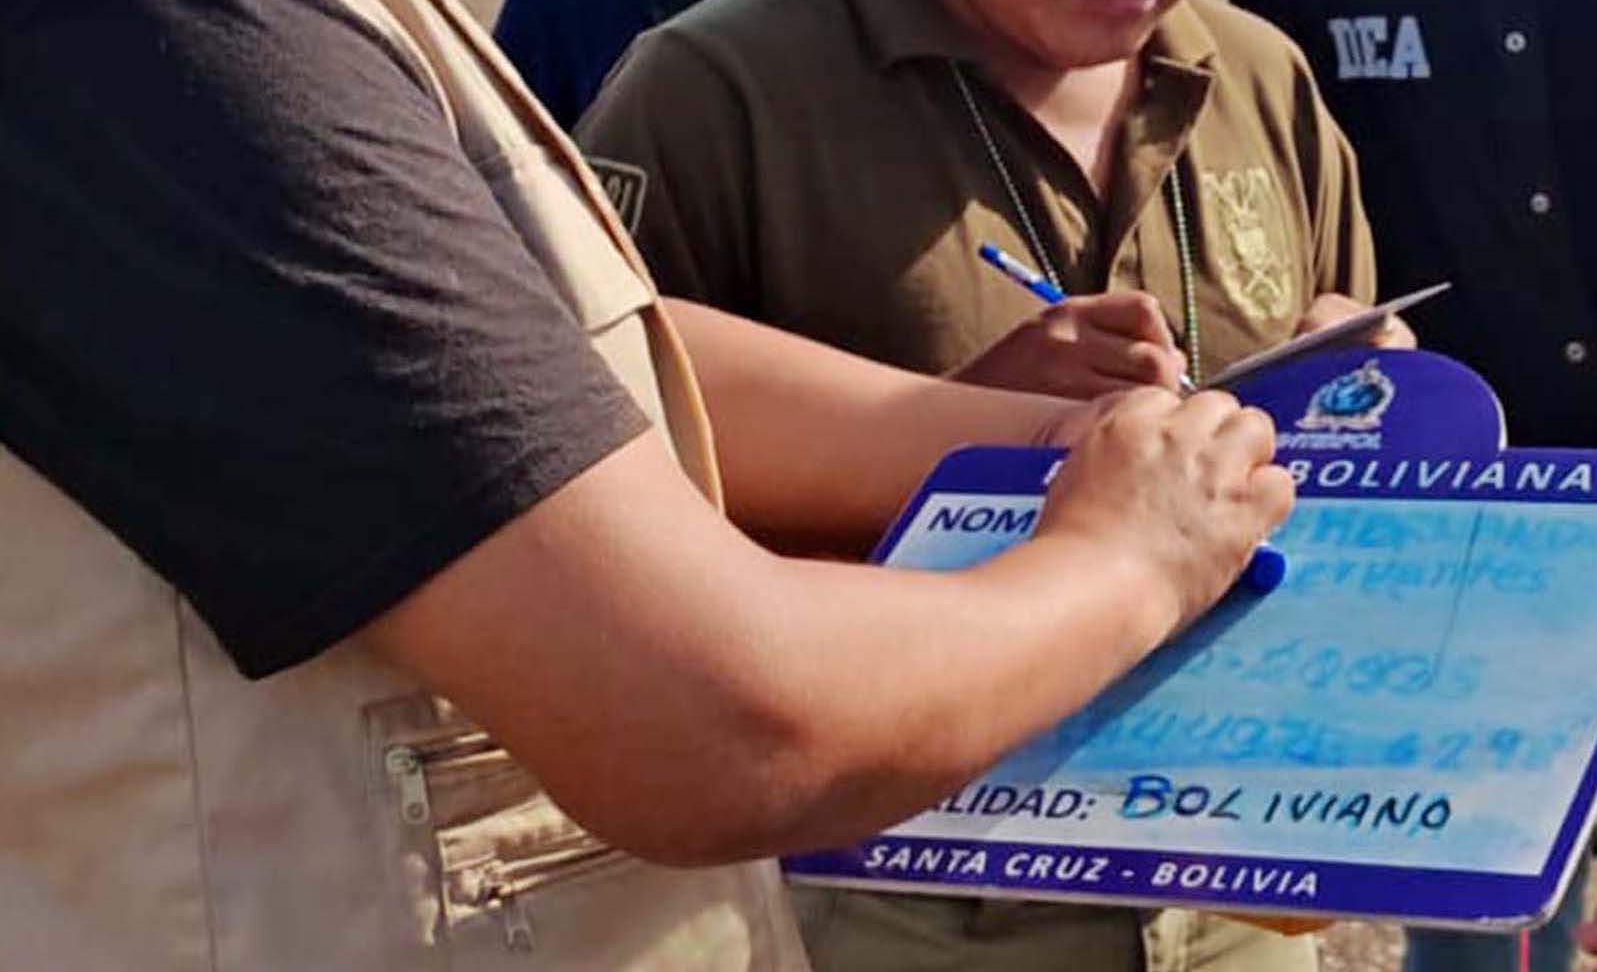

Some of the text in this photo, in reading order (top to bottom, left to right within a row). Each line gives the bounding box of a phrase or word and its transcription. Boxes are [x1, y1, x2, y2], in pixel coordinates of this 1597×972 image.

[1327, 15, 1431, 80] DEA
[1288, 459, 1594, 492] BOLIVIANA
[928, 507, 1038, 535] NOM
[933, 782, 1097, 821] LIDAD:
[864, 842, 988, 876] SANTA
[1004, 852, 1111, 882] CRUZ
[1151, 861, 1320, 896] BOLIVIA
